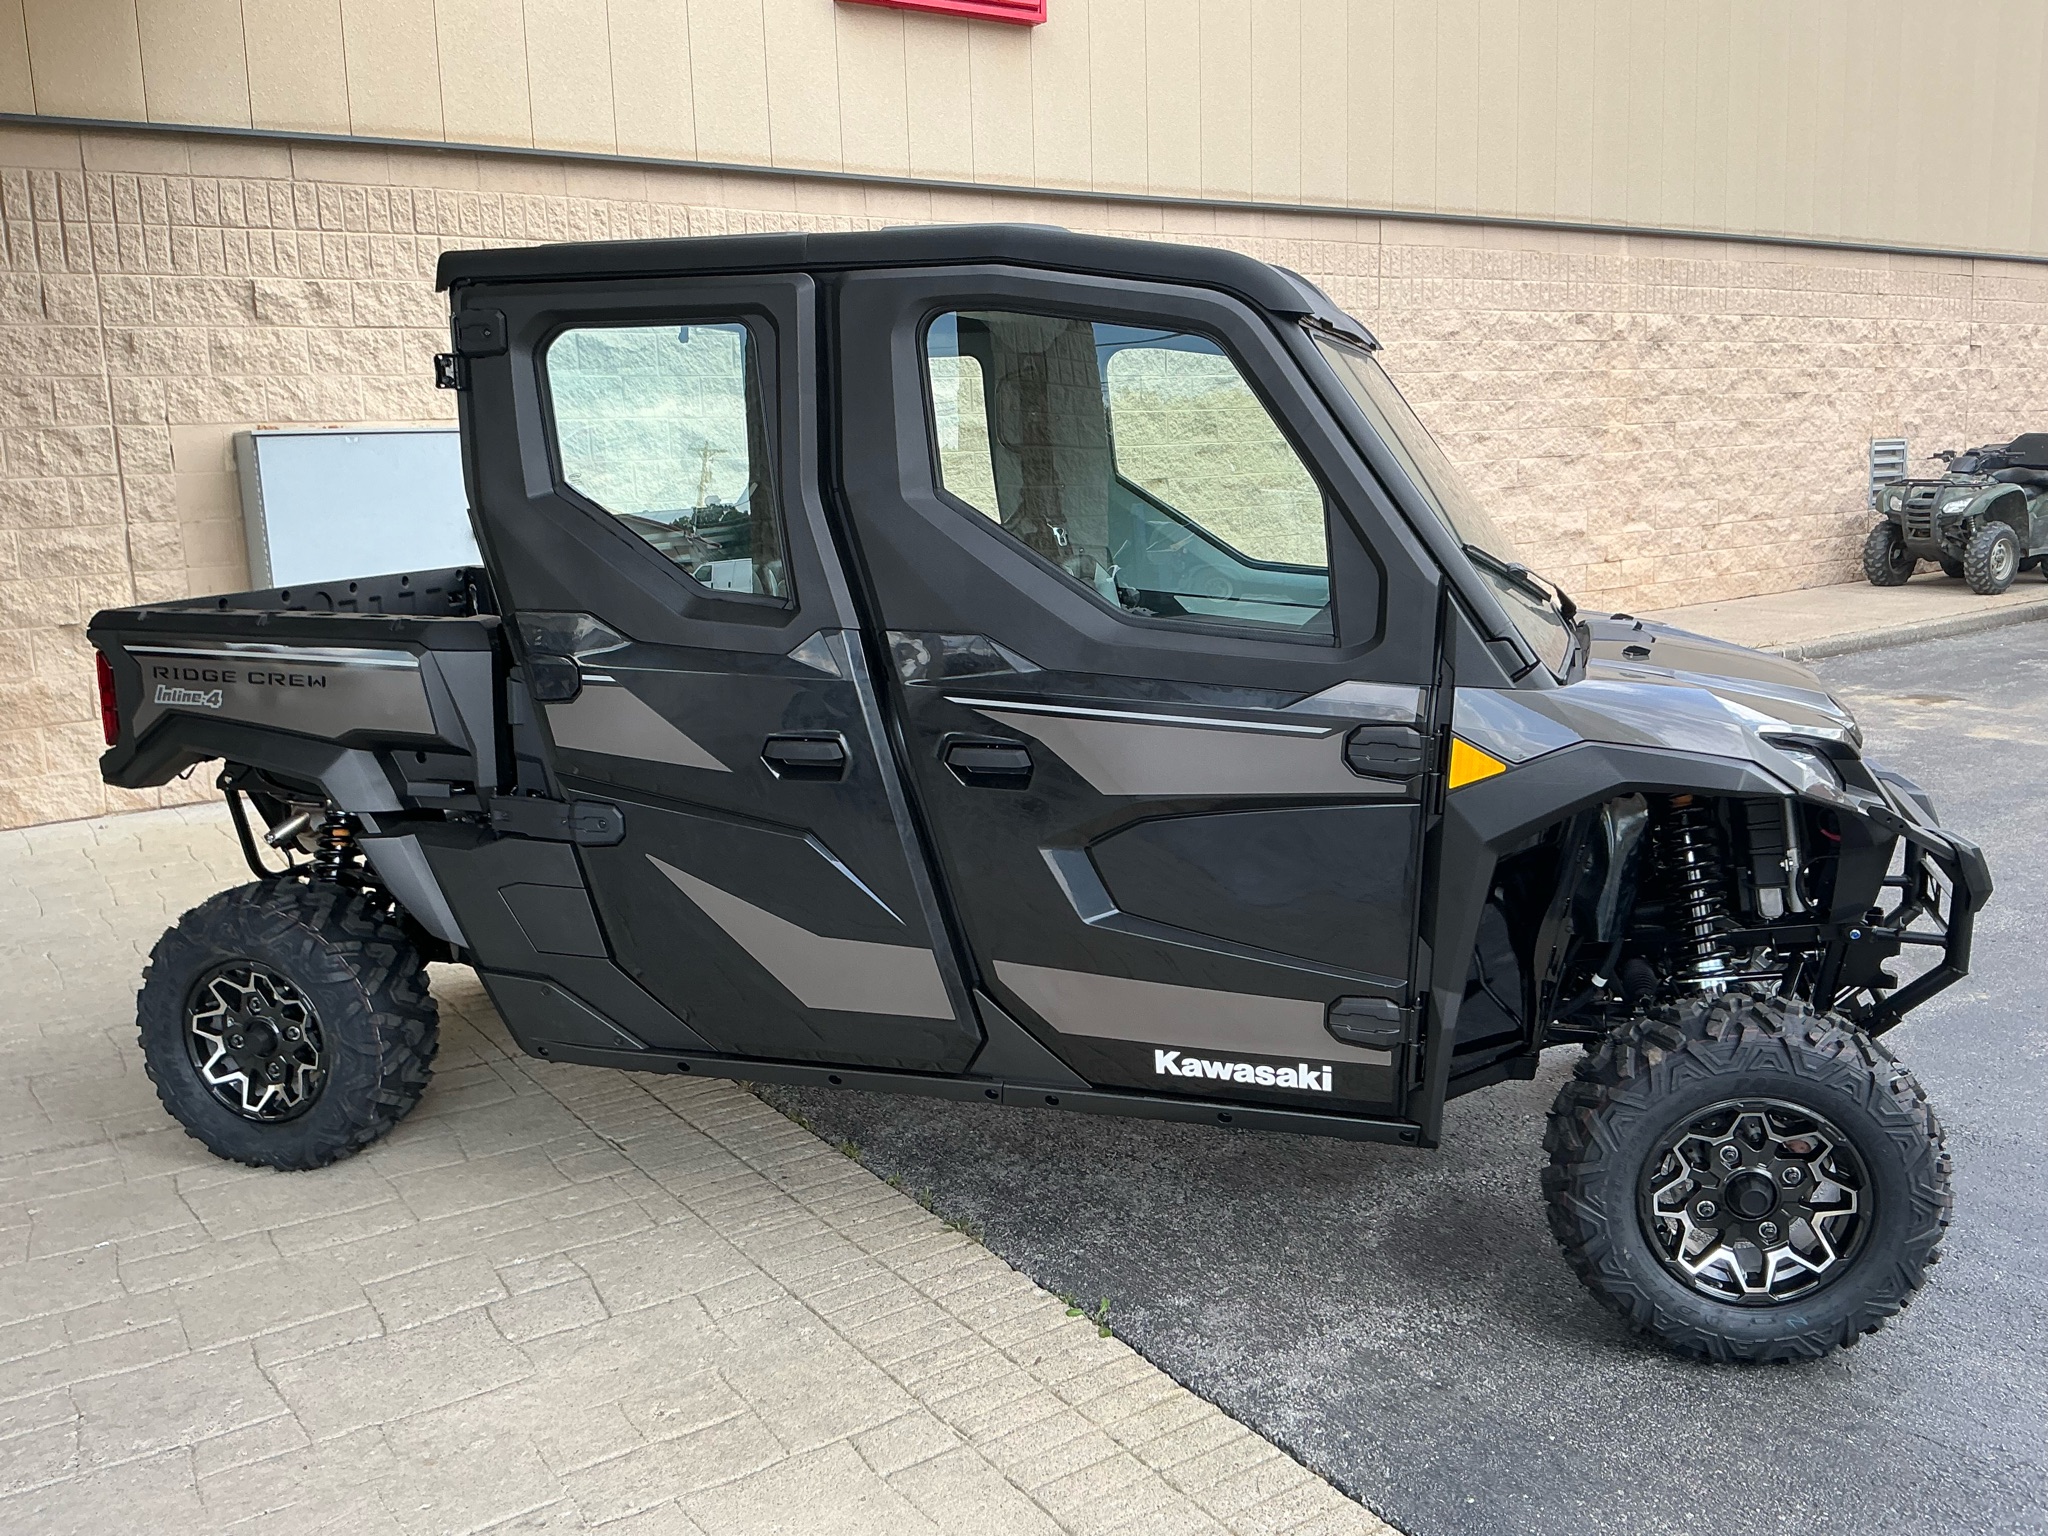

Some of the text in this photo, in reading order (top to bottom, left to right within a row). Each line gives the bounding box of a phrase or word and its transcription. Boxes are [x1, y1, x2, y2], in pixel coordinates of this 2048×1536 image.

[152, 666, 326, 688] RIDGE CREW
[1154, 1049, 1333, 1092] Kawasaki
